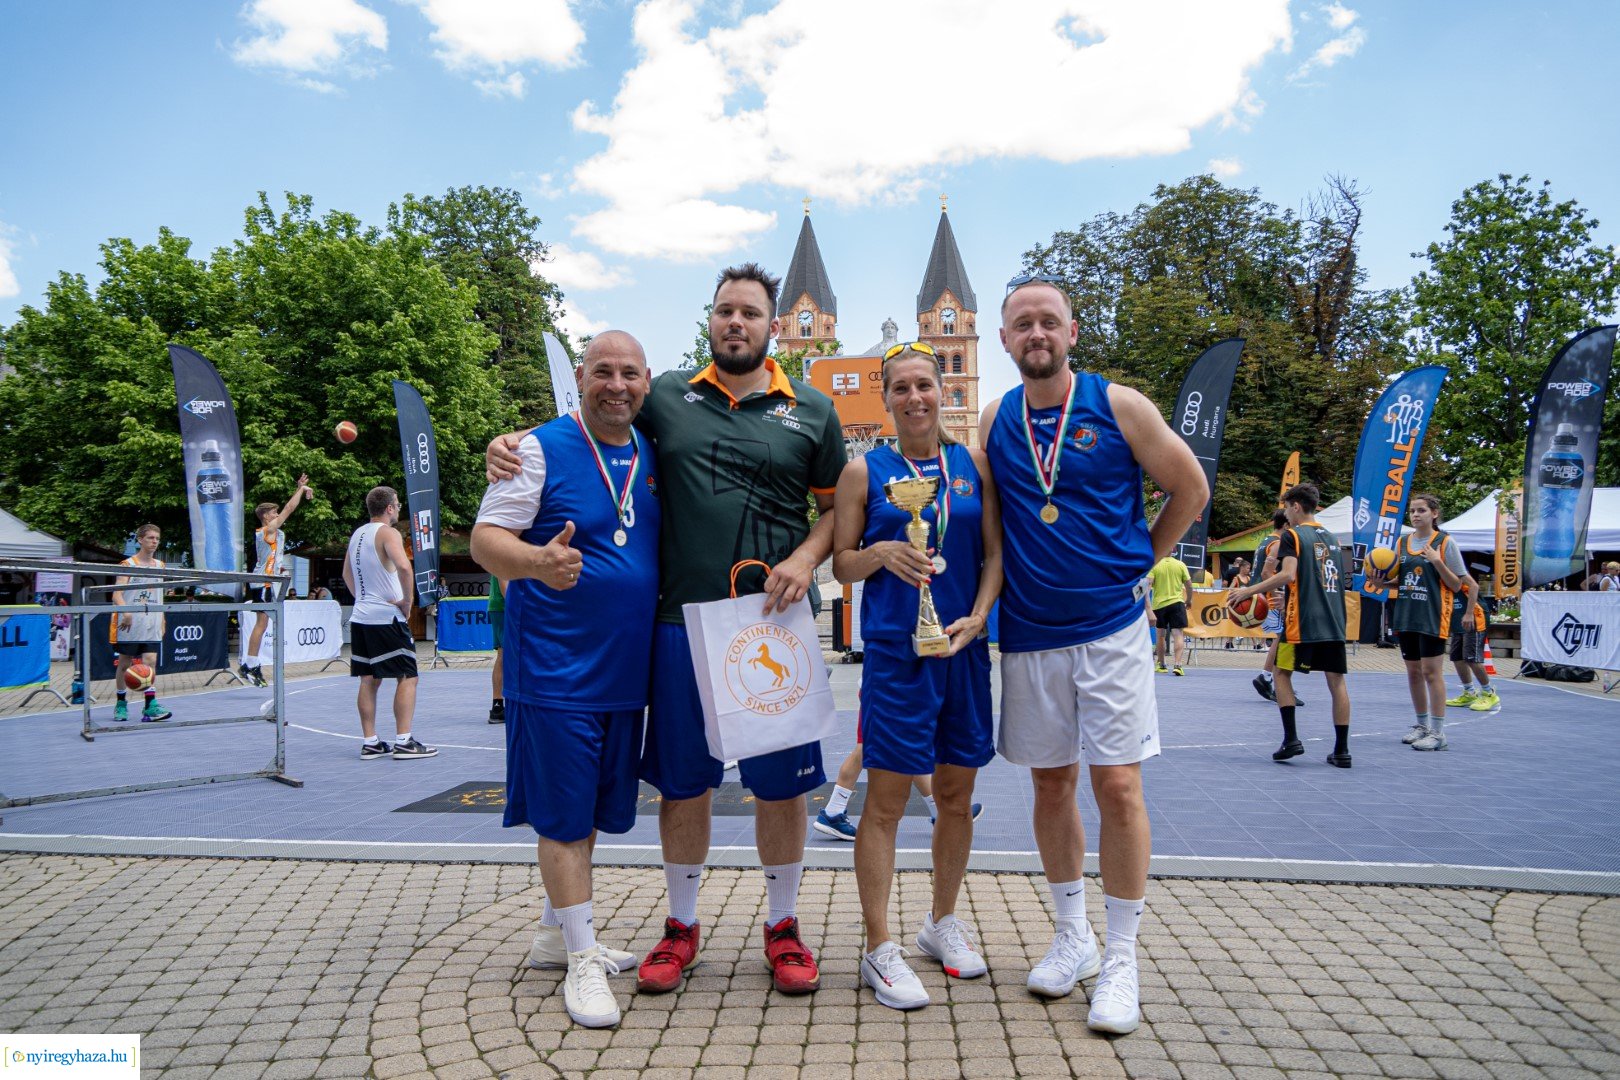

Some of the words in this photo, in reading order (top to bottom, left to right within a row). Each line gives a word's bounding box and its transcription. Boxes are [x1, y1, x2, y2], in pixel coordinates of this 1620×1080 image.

[1547, 382, 1592, 390] POWER
[1564, 389, 1590, 397] ADE
[1039, 417, 1057, 425] JAKO
[1202, 419, 1210, 438] Audi
[1210, 406, 1220, 439] Hungaria
[922, 464, 940, 472] JAKO
[1540, 464, 1579, 472] POWER
[1552, 471, 1578, 479] ADE
[356, 532, 366, 566] UNDER
[356, 567, 366, 600] ARMO
[0, 625, 28, 647] LL
[728, 625, 799, 664] CONTINENTAL
[1563, 622, 1602, 649] TOTI
[174, 654, 197, 662] Hungaria
[744, 697, 782, 713] SINCE
[784, 685, 804, 708] 1871
